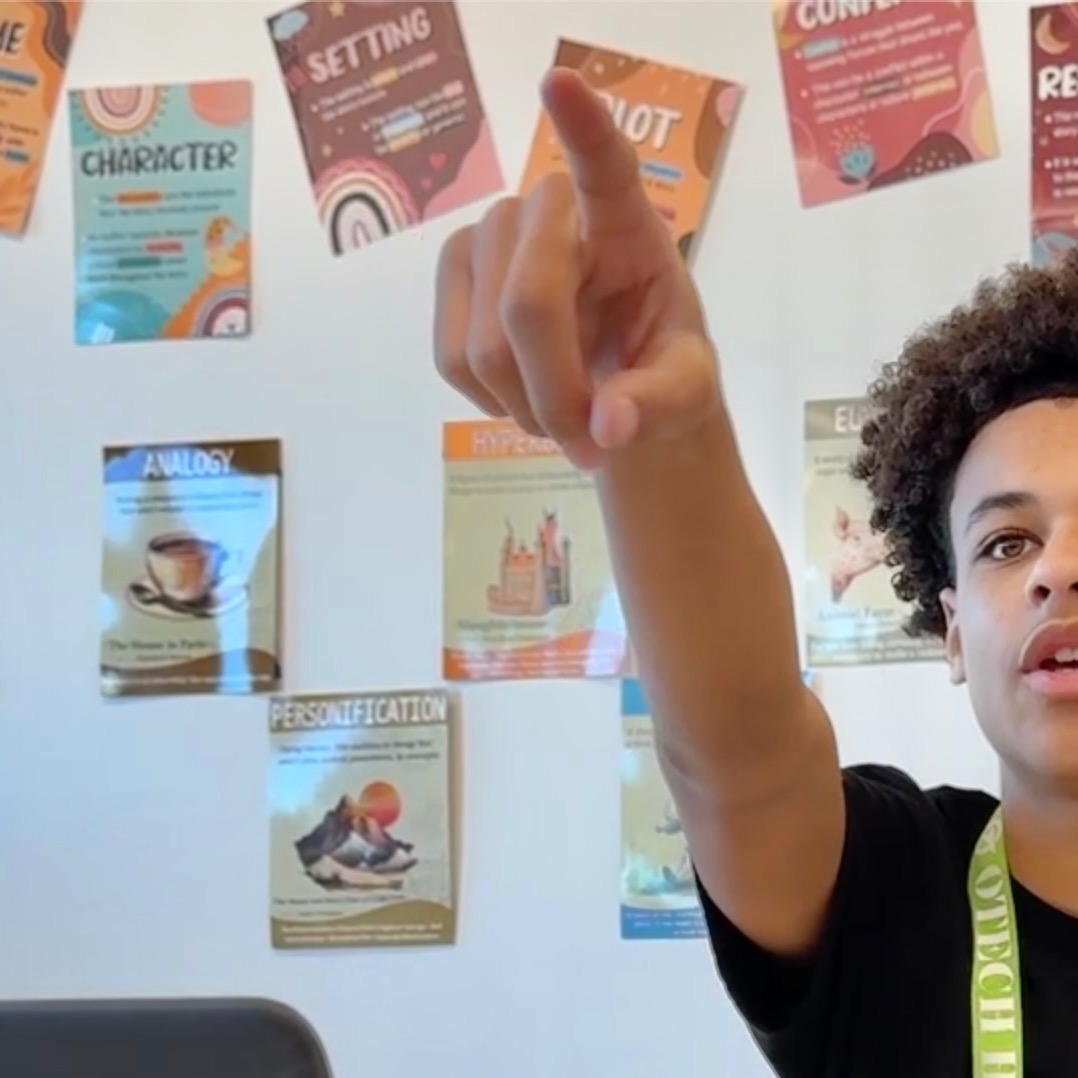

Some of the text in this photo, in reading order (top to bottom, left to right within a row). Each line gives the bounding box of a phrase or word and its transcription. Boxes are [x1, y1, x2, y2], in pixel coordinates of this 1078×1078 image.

[307, 7, 431, 83] SETTING
[81, 140, 237, 177] CHARACTER
[142, 448, 235, 478] ANALOGY
[272, 696, 446, 728] PERSONIFICATION
[975, 864, 1016, 1032] OTECH
